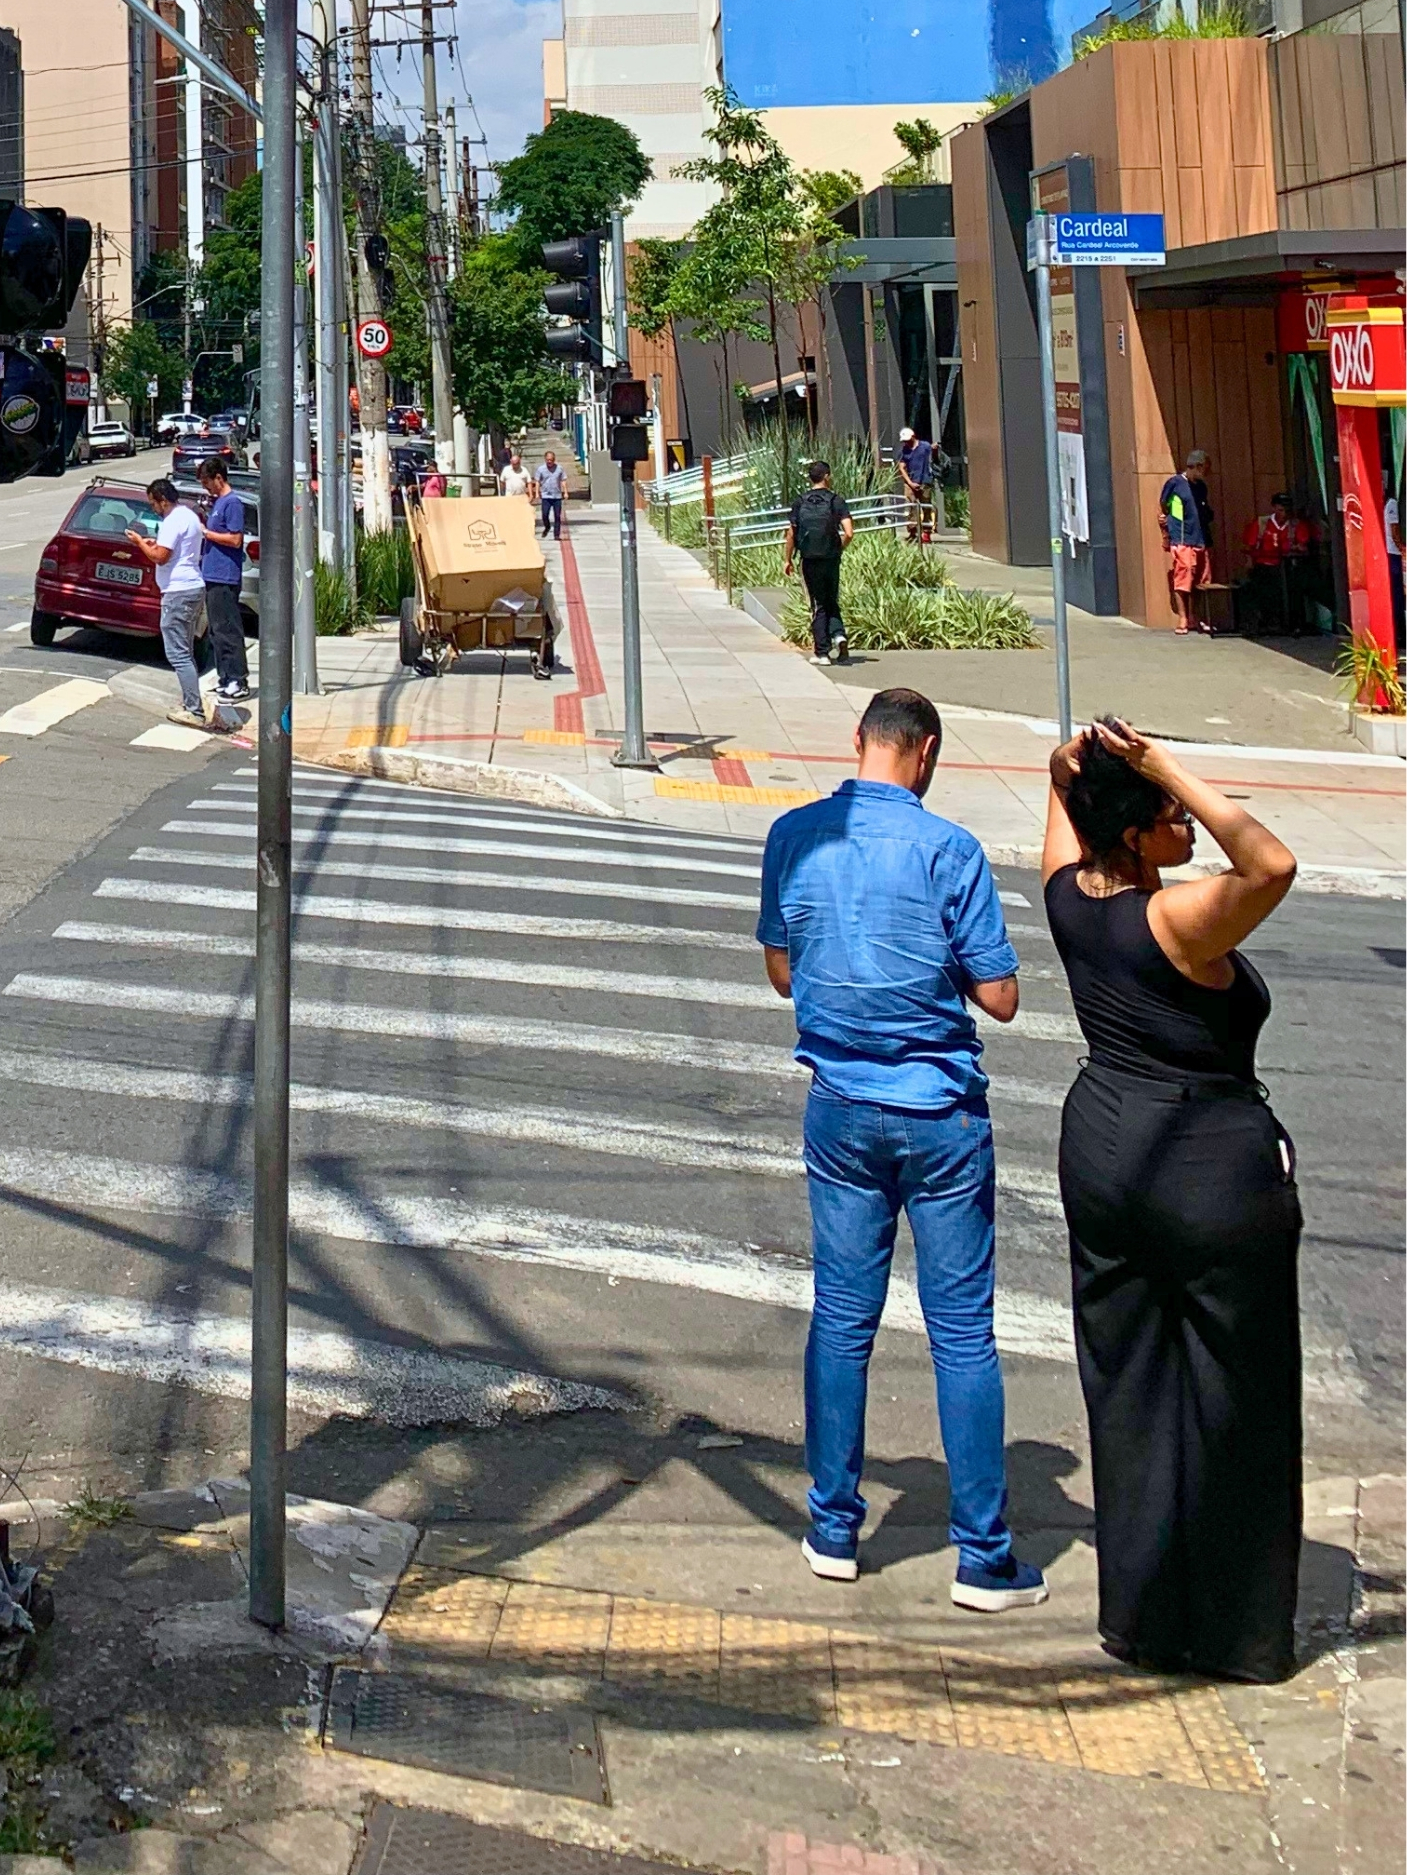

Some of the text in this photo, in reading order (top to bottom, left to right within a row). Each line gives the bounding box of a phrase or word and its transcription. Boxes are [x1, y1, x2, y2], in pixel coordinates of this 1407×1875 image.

[1060, 217, 1128, 238] Cardeal
[1061, 241, 1076, 249] Rua
[363, 327, 386, 345] 50
[1331, 324, 1375, 391] OXXO
